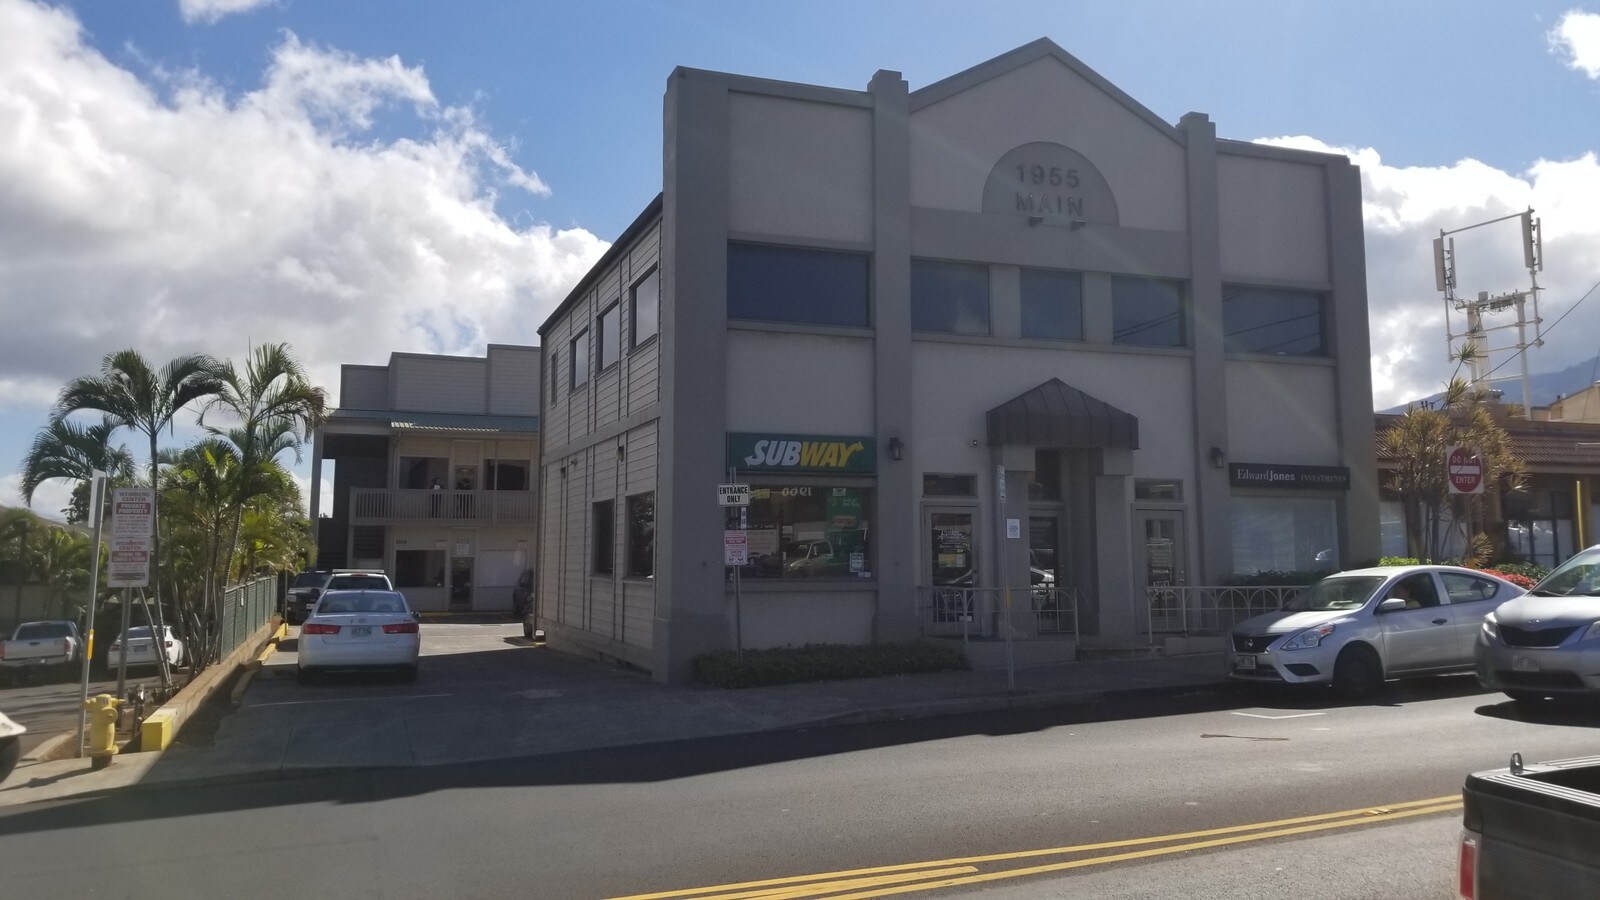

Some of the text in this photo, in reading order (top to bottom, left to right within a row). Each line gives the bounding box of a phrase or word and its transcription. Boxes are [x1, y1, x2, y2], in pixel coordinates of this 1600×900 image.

[1015, 163, 1080, 188] 1955
[1015, 191, 1084, 216] MAIN
[744, 439, 864, 468] SUBWAY
[1300, 473, 1346, 483] INVESTMENTS
[1456, 476, 1476, 484] ENTER
[719, 486, 748, 494] ENTRANCE
[726, 495, 741, 503] ONLY
